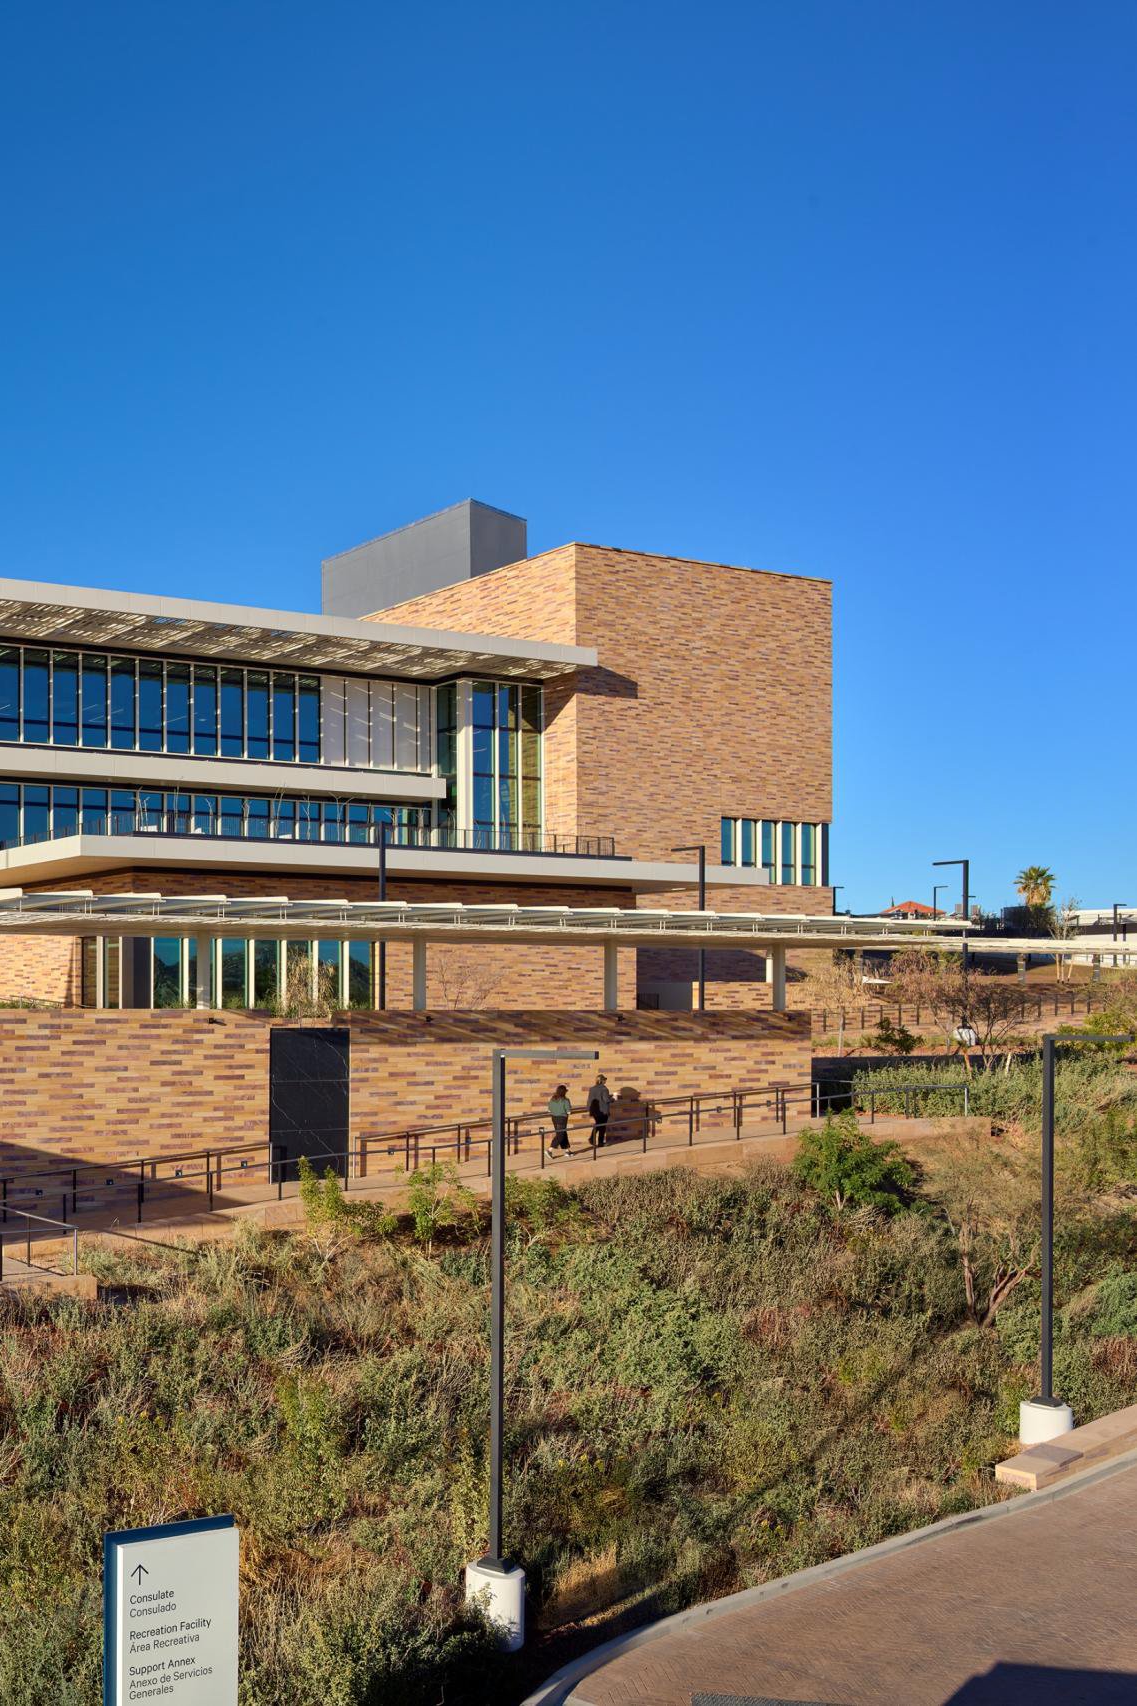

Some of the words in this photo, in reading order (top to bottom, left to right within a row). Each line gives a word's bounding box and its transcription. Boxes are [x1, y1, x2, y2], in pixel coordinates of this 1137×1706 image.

[129, 1590, 175, 1604] Consulate
[129, 1602, 177, 1618] Consulado
[129, 1624, 177, 1640] Recreation
[180, 1618, 211, 1631] Facility
[129, 1641, 151, 1654] Área
[153, 1634, 199, 1649] Recreativa
[129, 1662, 165, 1676] Support
[167, 1657, 195, 1668] Annex
[129, 1677, 158, 1689] Anexo
[160, 1673, 171, 1683] de
[173, 1666, 213, 1681] Servicios
[129, 1684, 174, 1700] Generales
